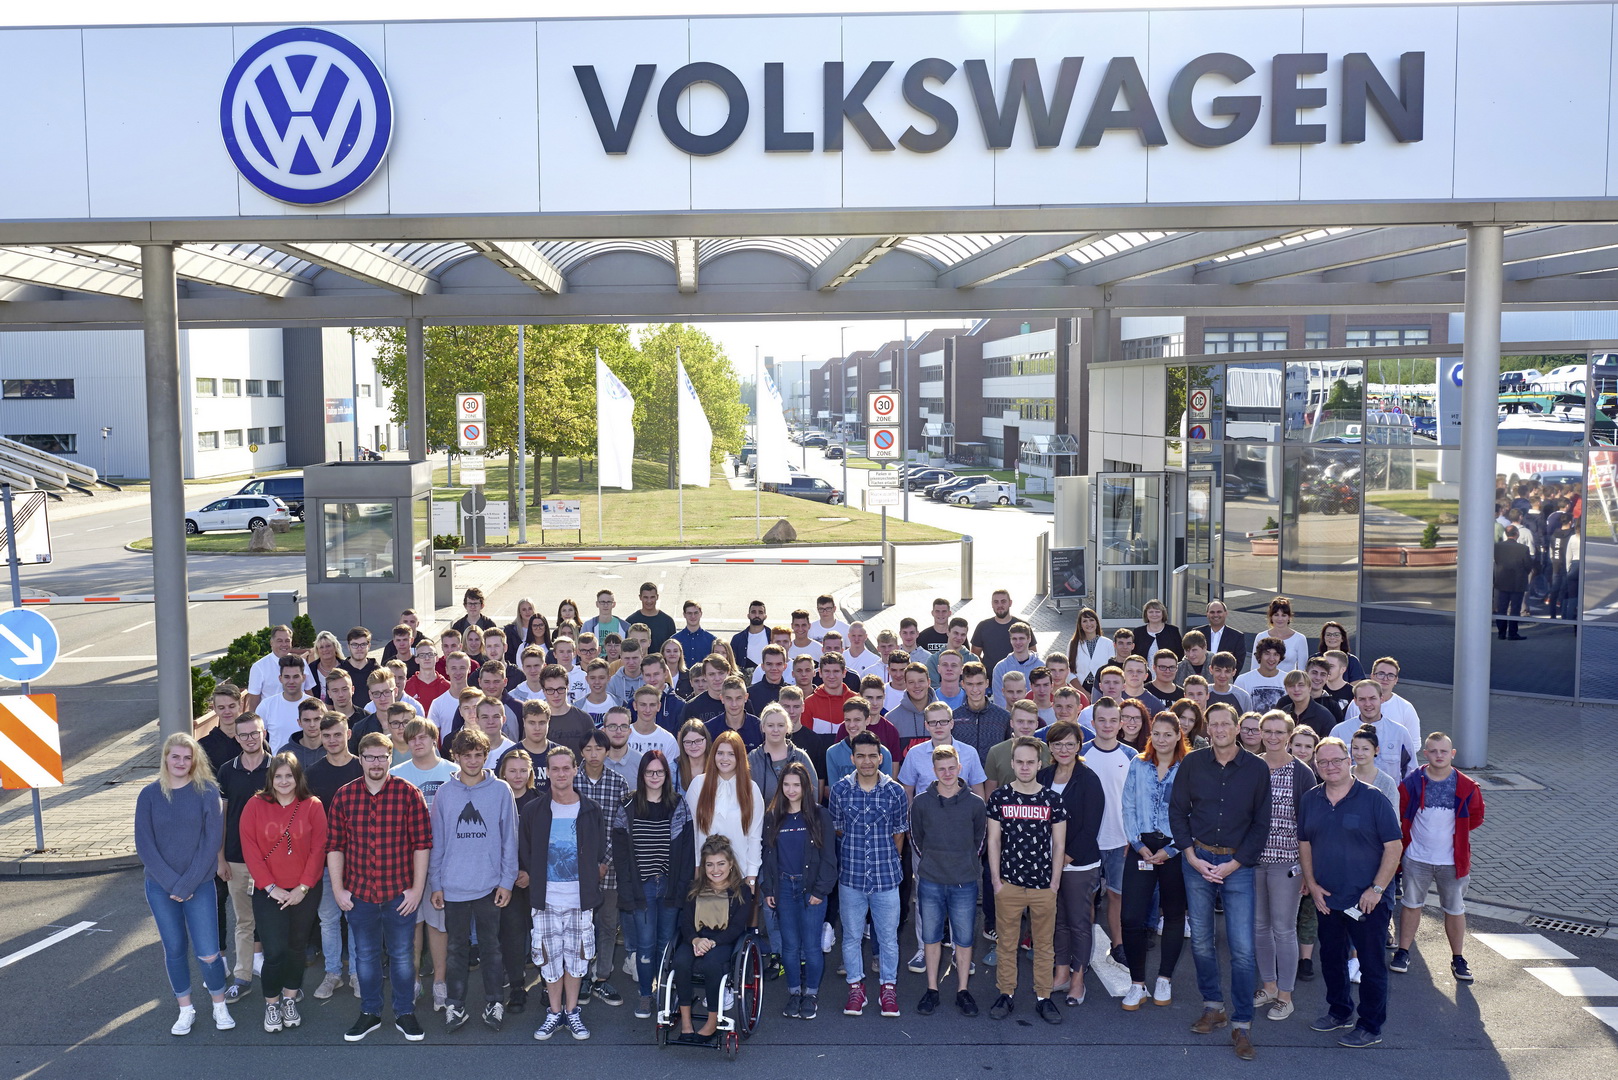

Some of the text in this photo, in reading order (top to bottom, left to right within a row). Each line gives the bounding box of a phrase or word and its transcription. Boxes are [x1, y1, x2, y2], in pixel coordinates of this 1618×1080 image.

[573, 51, 1425, 157] VOLKSWAGEN
[466, 401, 476, 410] 30
[878, 400, 890, 410] 30
[438, 565, 447, 578] 2
[868, 570, 875, 583] 1
[1003, 805, 1050, 819] OBVIOUSLY
[456, 831, 487, 839] BURTON
